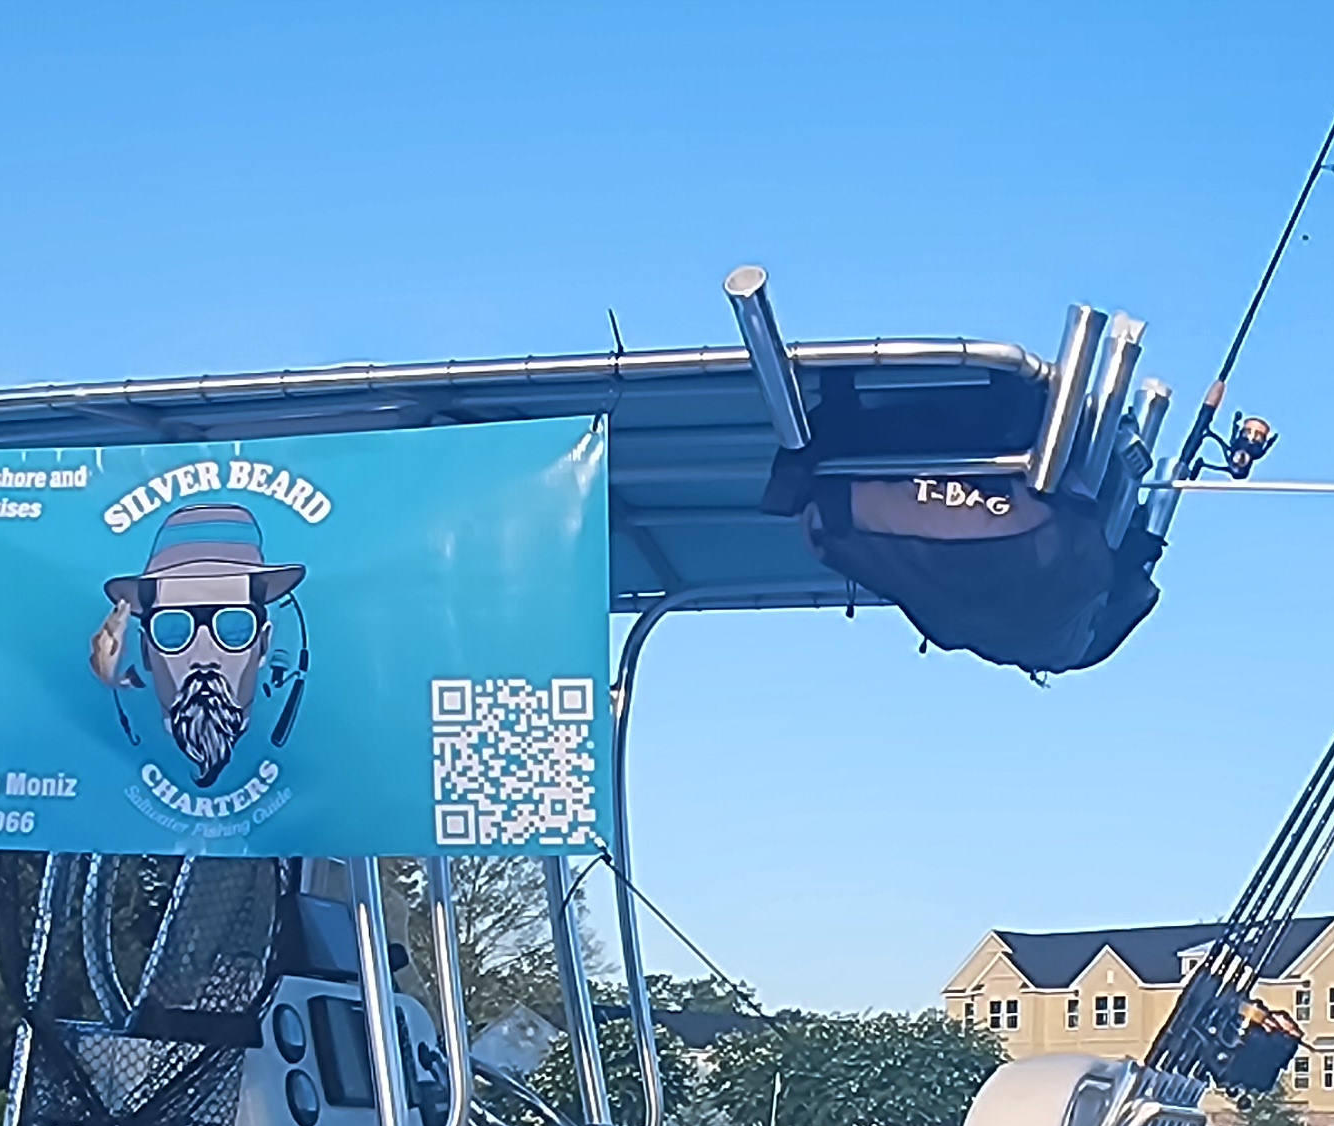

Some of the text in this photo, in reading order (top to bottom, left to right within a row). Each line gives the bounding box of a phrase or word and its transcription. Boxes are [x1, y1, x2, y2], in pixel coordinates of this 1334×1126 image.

[49, 465, 87, 488] and
[104, 461, 332, 533] SILVER BEARD
[913, 478, 1010, 515] T-BAG
[5, 772, 78, 797] Moniz
[141, 760, 279, 817] CHARTERS
[124, 785, 294, 838] Saltwater Fishing Guide
